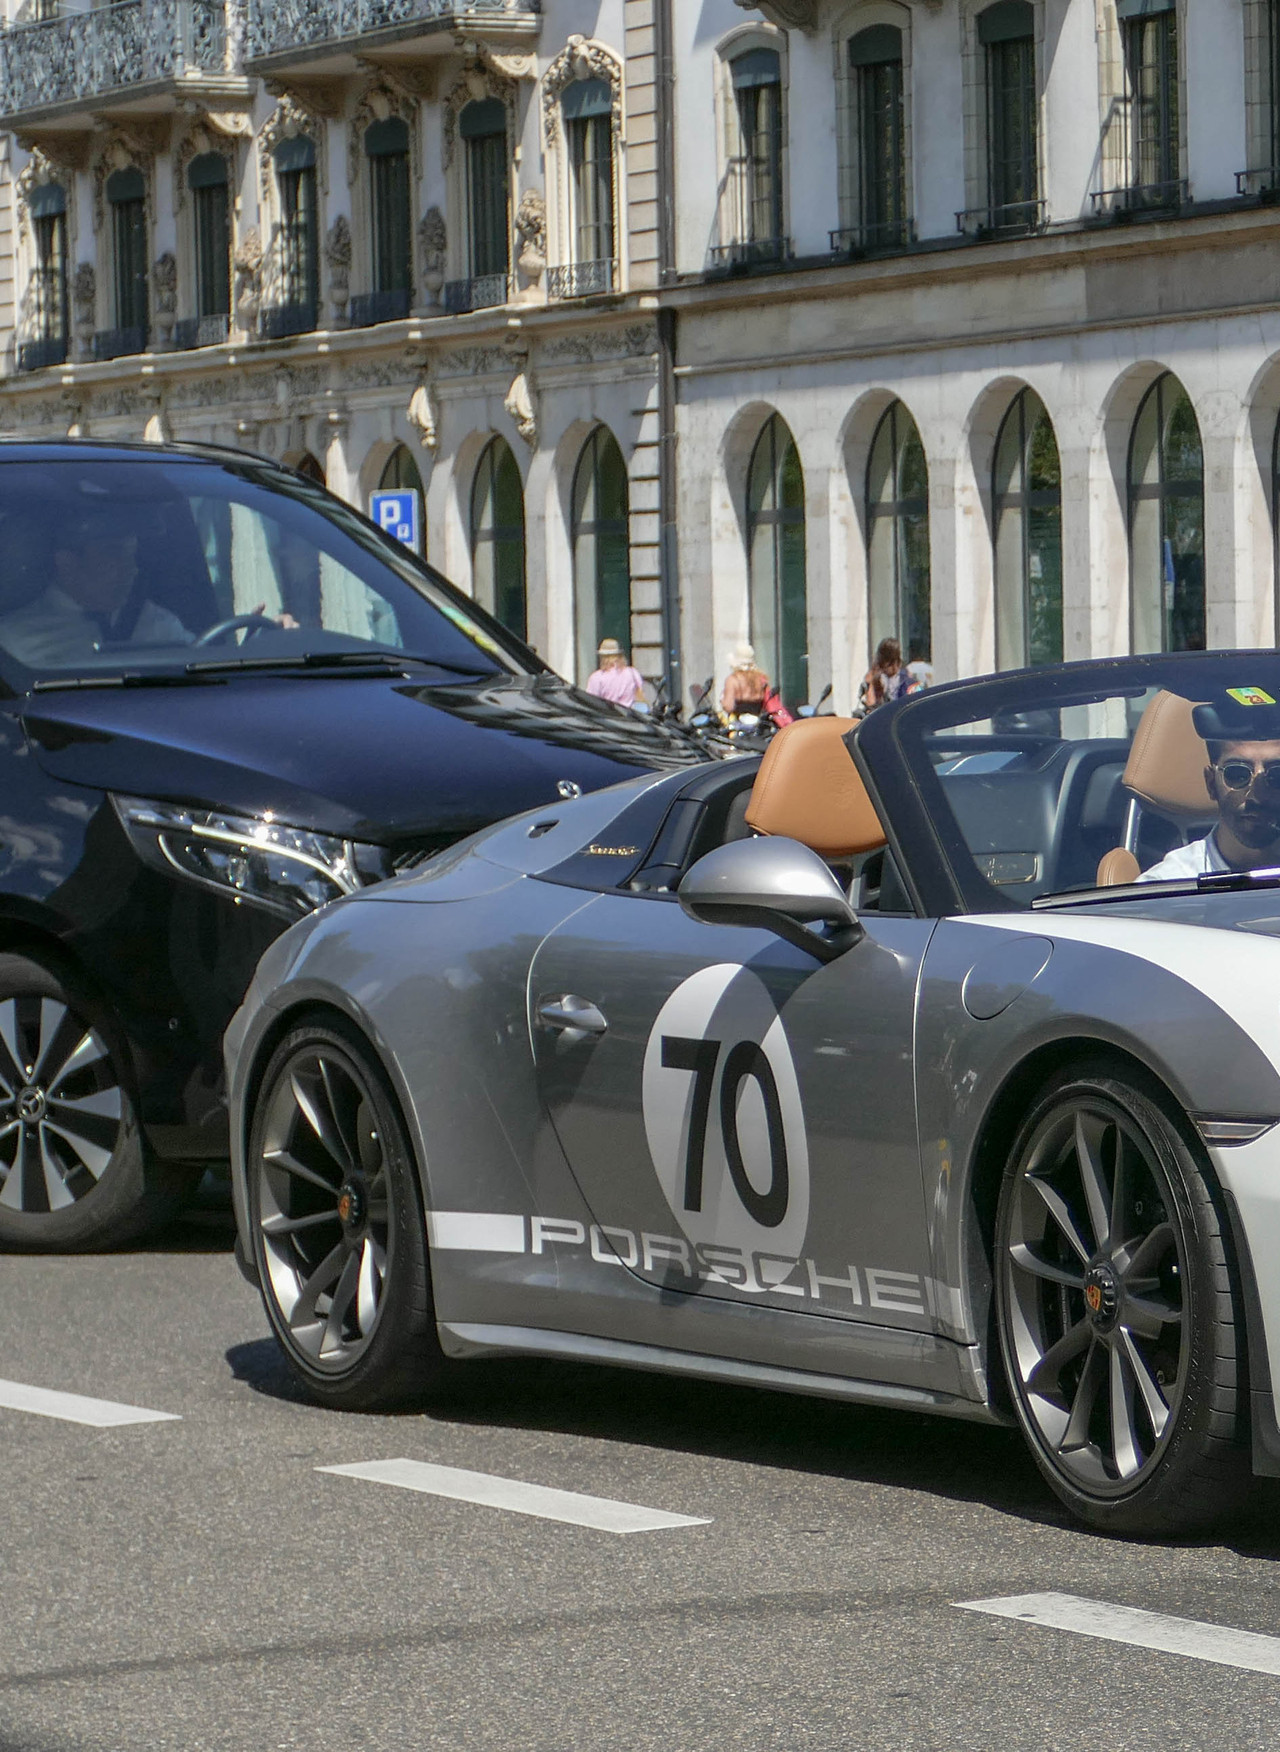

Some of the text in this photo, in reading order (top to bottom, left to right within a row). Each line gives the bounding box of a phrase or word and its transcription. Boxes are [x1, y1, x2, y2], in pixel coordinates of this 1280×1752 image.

[380, 500, 400, 531] P
[661, 1035, 789, 1227] 70
[531, 1215, 925, 1315] PORSCHE
